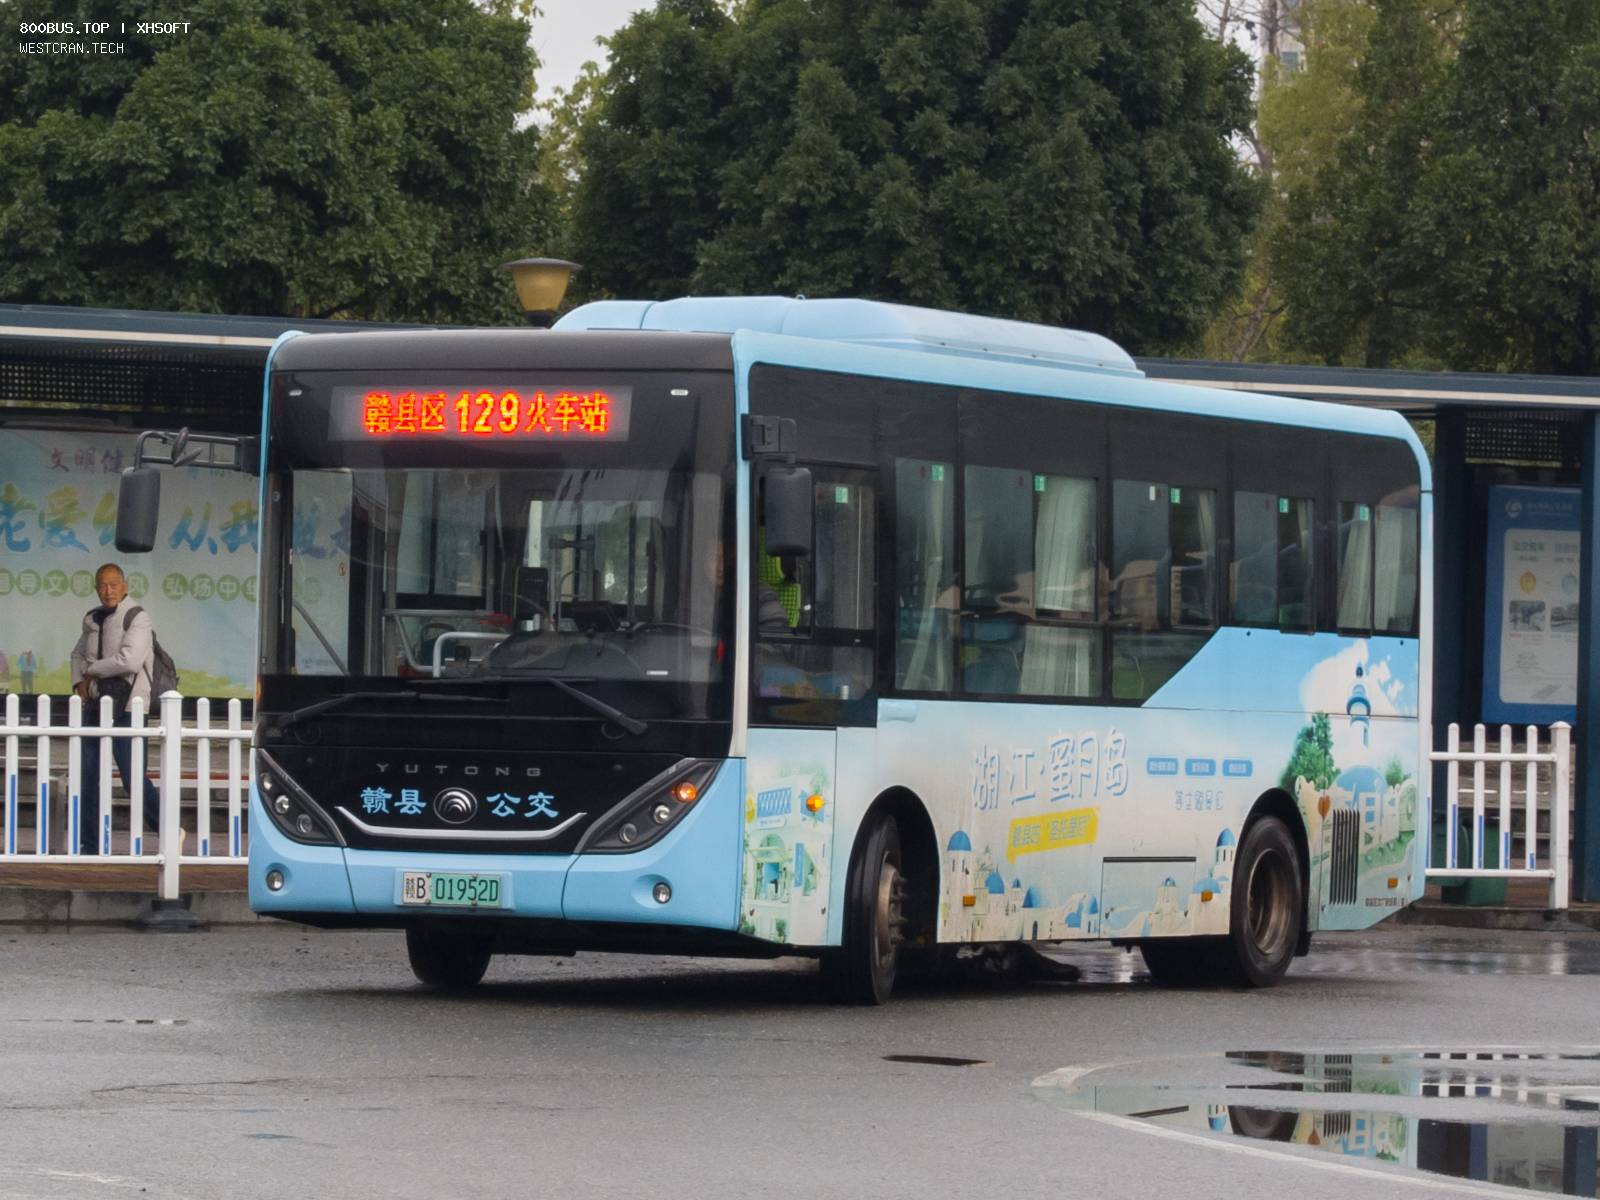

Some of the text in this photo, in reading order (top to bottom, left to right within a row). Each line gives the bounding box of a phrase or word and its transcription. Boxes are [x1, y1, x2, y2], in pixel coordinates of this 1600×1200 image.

[363, 392, 609, 433] 赣县区 129 火车站
[377, 763, 541, 777] YUTONG
[360, 786, 559, 818] 赣县 公交
